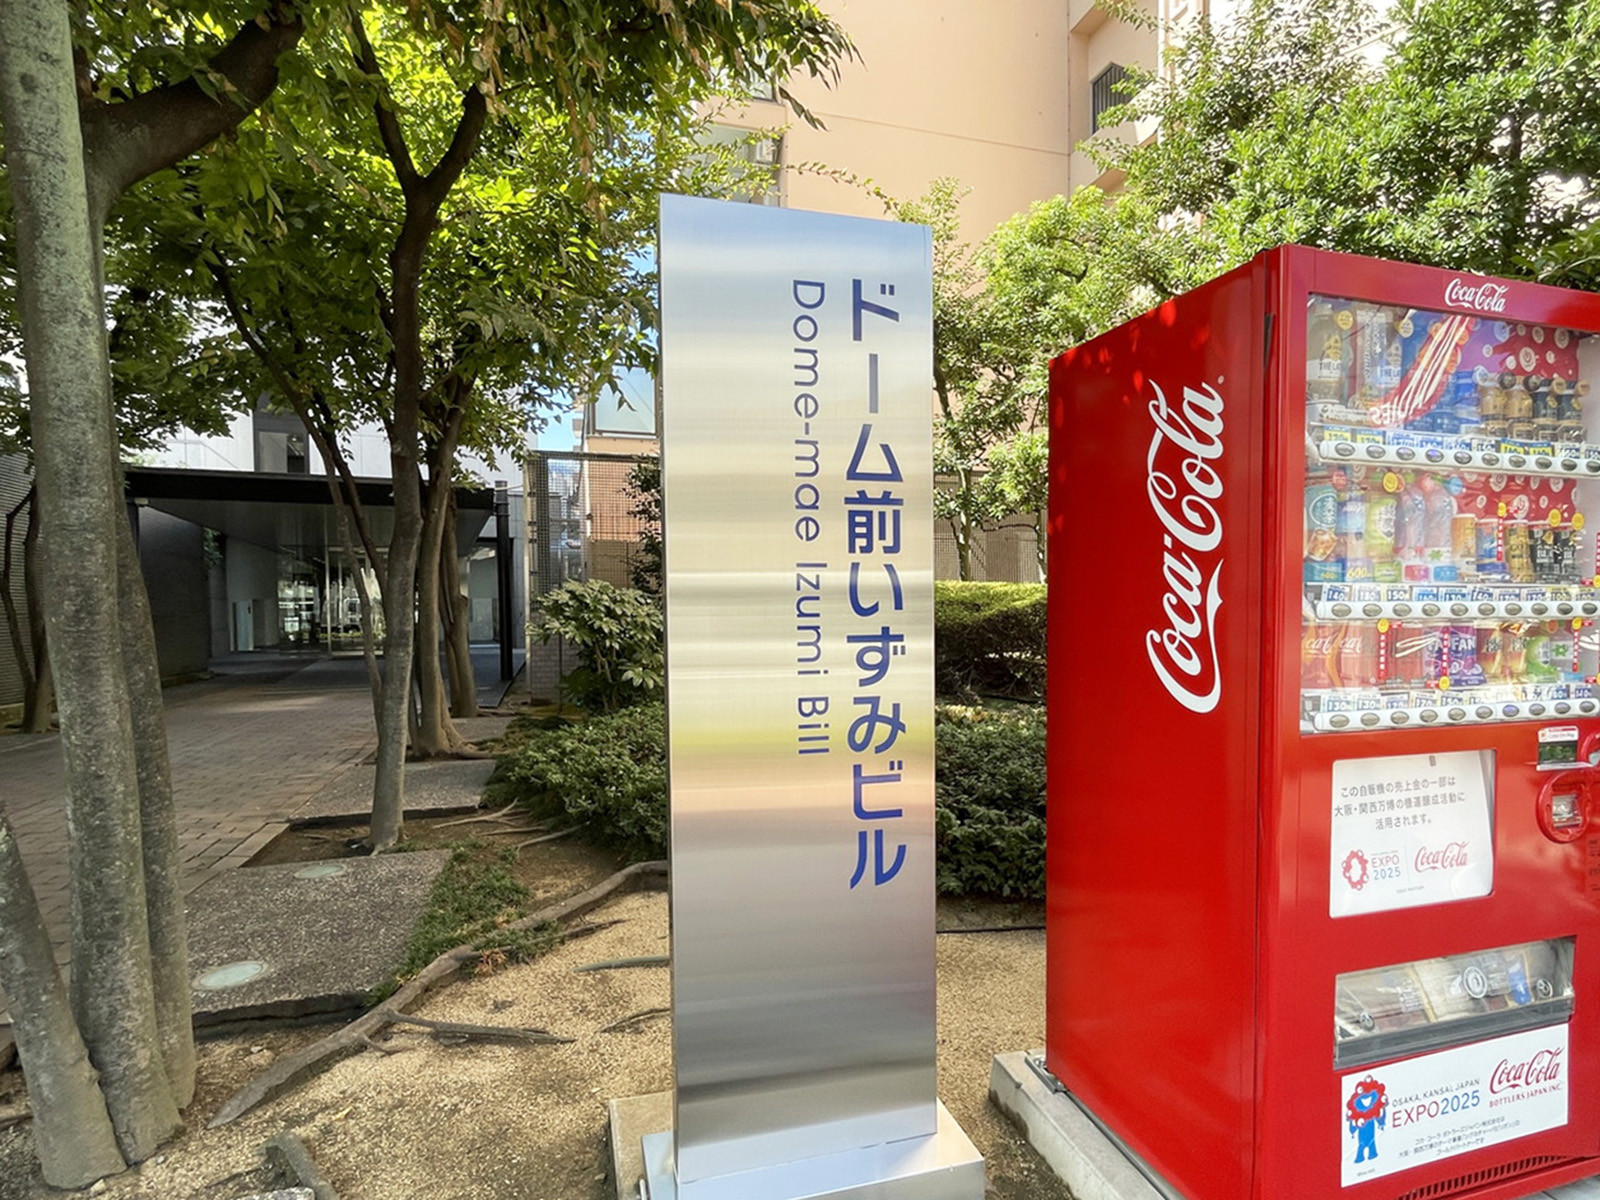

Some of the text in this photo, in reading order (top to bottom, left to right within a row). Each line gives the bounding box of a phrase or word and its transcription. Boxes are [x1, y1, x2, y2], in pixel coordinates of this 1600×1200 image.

[1444, 278, 1509, 312] Coca-Cola
[793, 279, 830, 755] Dome-mae Izumi Bill
[1146, 378, 1224, 714] Coca-Cola
[844, 278, 907, 890] ドーム前いずみビル
[1341, 776, 1456, 798] この自販機の売上金の一部は
[1371, 854, 1399, 868] EXPO
[1373, 866, 1401, 880] 2025
[1414, 841, 1469, 873] Coca-Cola
[1489, 1047, 1565, 1095] Coca-Cola
[1392, 1090, 1480, 1128] EXPO2025
[1489, 1093, 1526, 1109] BOTTLERS
[1526, 1087, 1547, 1100] JAPAN
